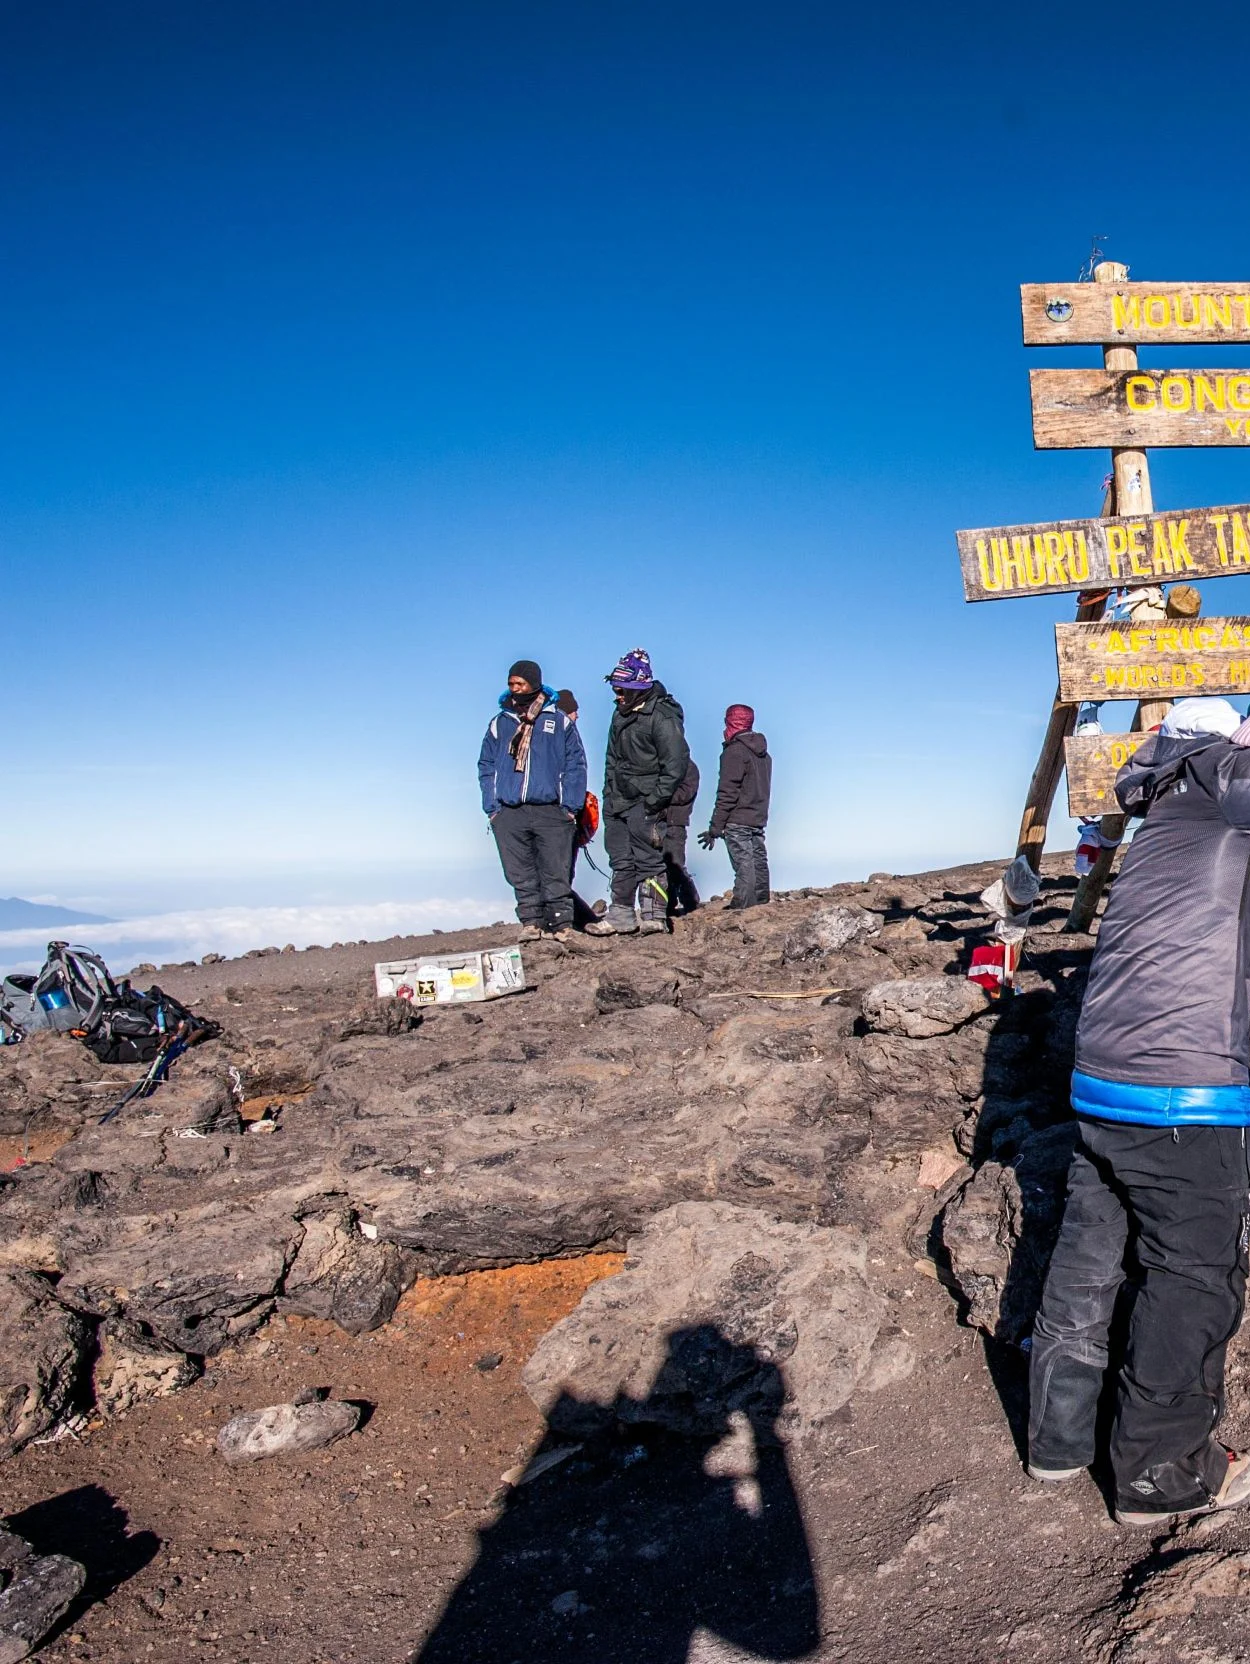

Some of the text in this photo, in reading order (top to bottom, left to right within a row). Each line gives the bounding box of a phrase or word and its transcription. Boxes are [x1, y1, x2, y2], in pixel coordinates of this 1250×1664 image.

[976, 530, 1090, 592] UHURU
[1104, 519, 1198, 579] PEAK
[1105, 662, 1206, 689] WORLD'S
